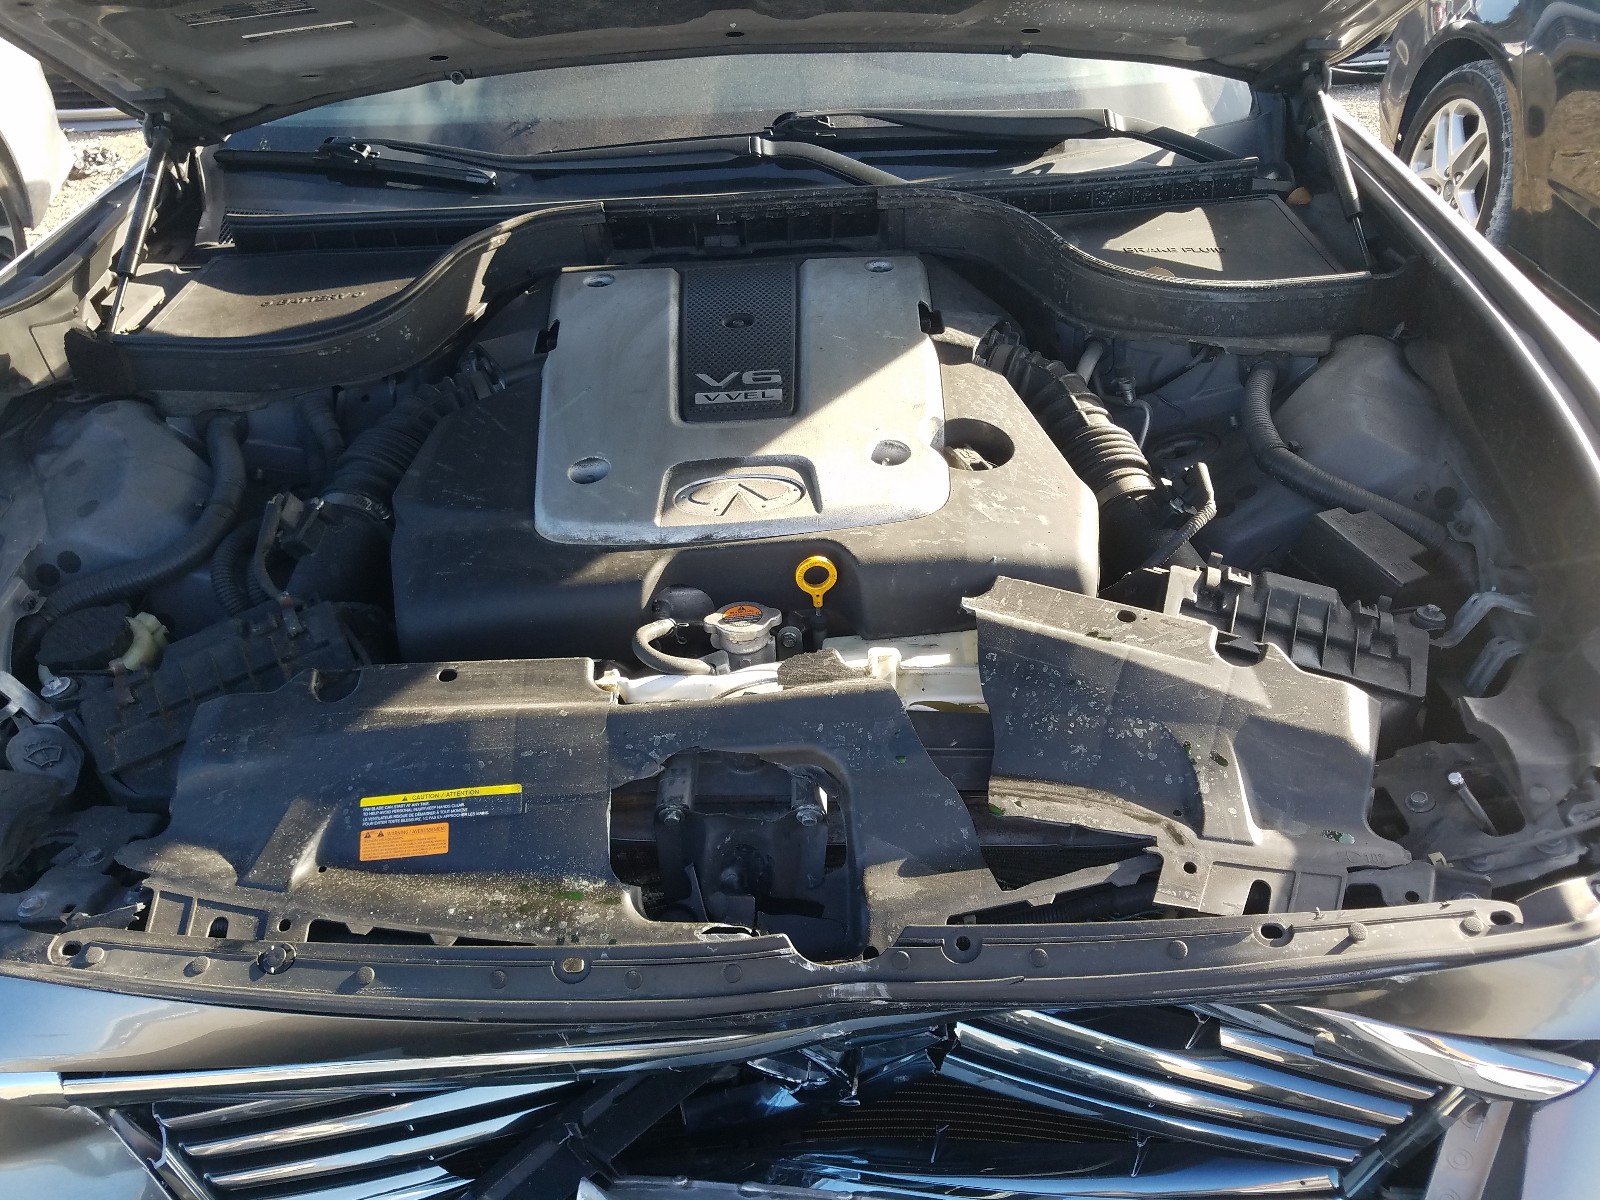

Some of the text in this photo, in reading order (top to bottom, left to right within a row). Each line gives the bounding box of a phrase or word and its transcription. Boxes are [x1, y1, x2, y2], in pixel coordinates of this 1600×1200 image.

[695, 369, 783, 388] V6
[701, 390, 776, 402] VVEL
[411, 793, 440, 801] CAUTION
[445, 790, 480, 798] ATTENTION
